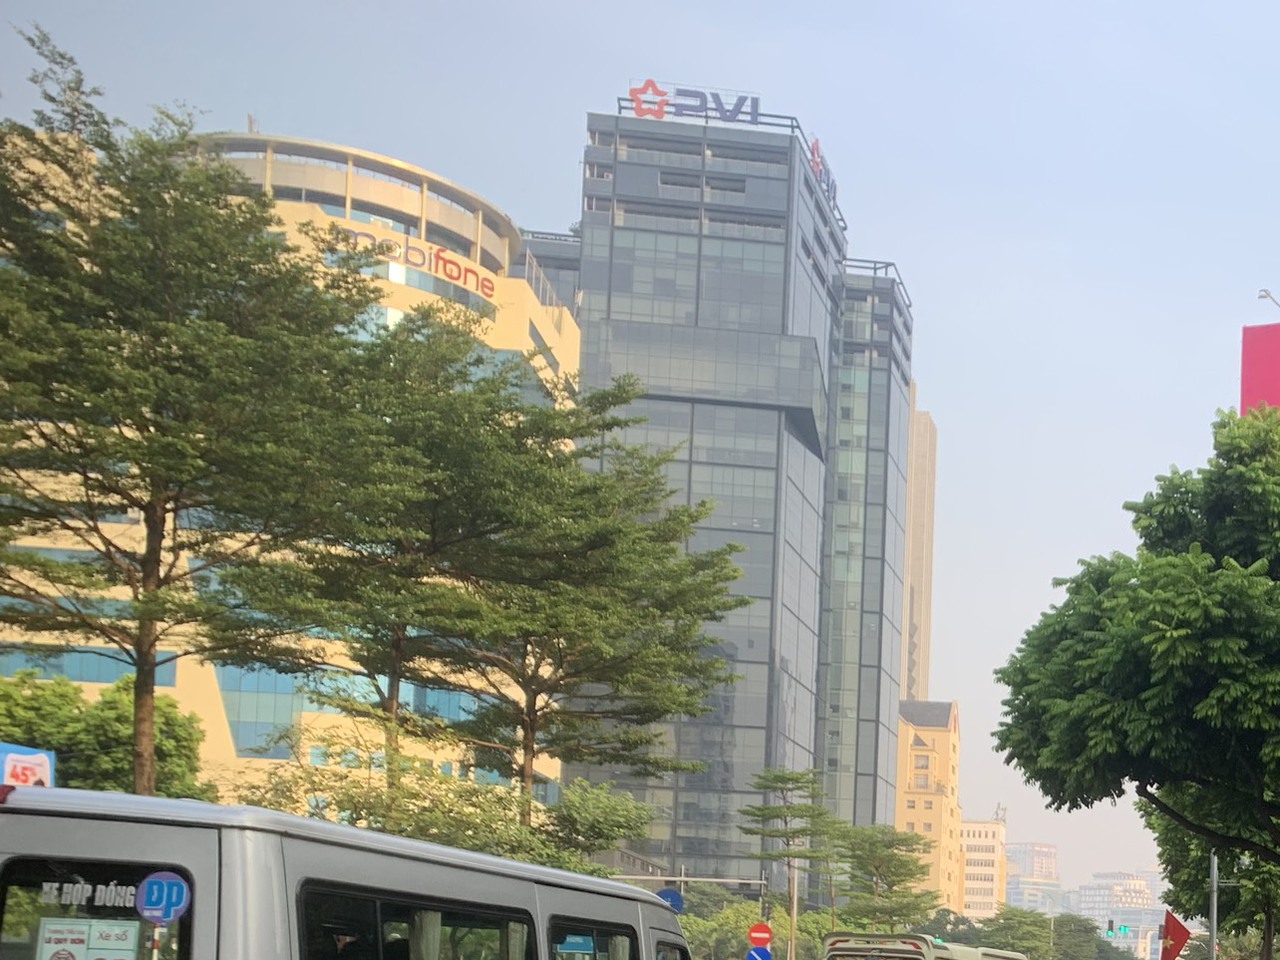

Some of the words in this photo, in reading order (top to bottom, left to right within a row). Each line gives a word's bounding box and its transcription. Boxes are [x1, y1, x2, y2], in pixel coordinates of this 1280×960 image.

[674, 88, 759, 125] PVI
[344, 228, 496, 299] mobifone
[42, 882, 59, 904] XE
[61, 877, 92, 908] HỢP
[97, 930, 112, 940] Xe
[114, 929, 129, 942] số
